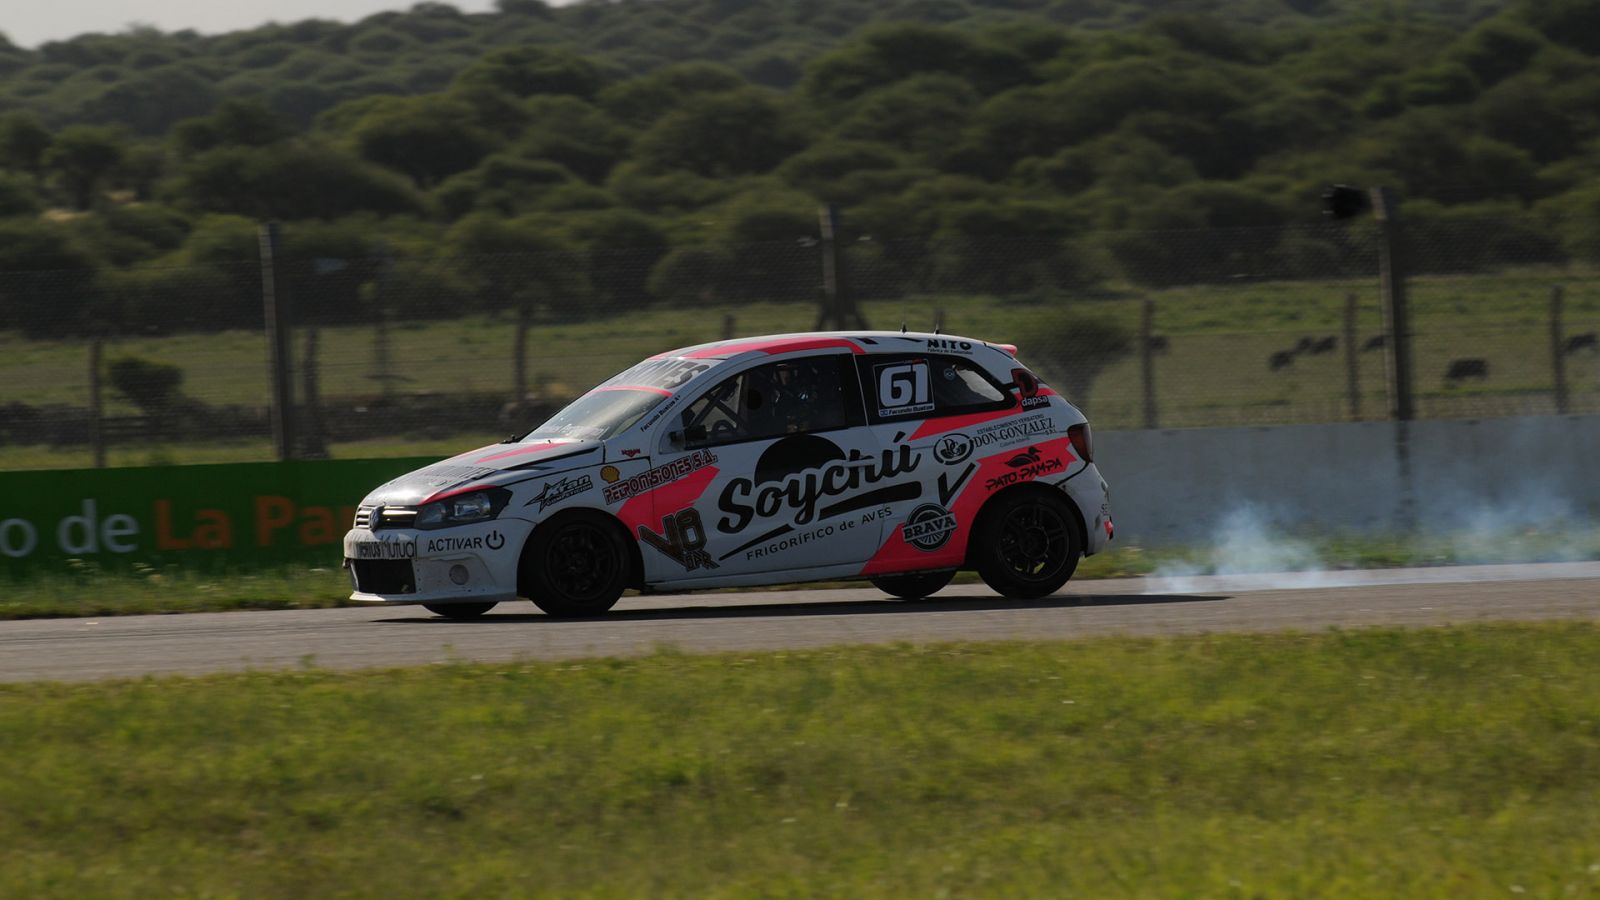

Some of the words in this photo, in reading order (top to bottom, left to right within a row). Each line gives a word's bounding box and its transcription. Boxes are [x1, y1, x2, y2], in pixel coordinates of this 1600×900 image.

[928, 340, 971, 350] NITO
[880, 363, 928, 407] 61
[1021, 395, 1049, 406] dapsa
[603, 456, 691, 504] PETROMISIONES
[692, 448, 717, 469] S.A.
[718, 431, 921, 533] Soychú
[985, 472, 1017, 490] PATO
[1019, 458, 1062, 479] PAMPA
[57, 499, 140, 555] de
[154, 499, 233, 551] La
[427, 537, 482, 552] ACTIVAR
[746, 527, 834, 560] FRIGORÍFICO
[839, 521, 855, 531] de
[862, 507, 892, 525] AVES
[904, 516, 956, 539] BRAVA
